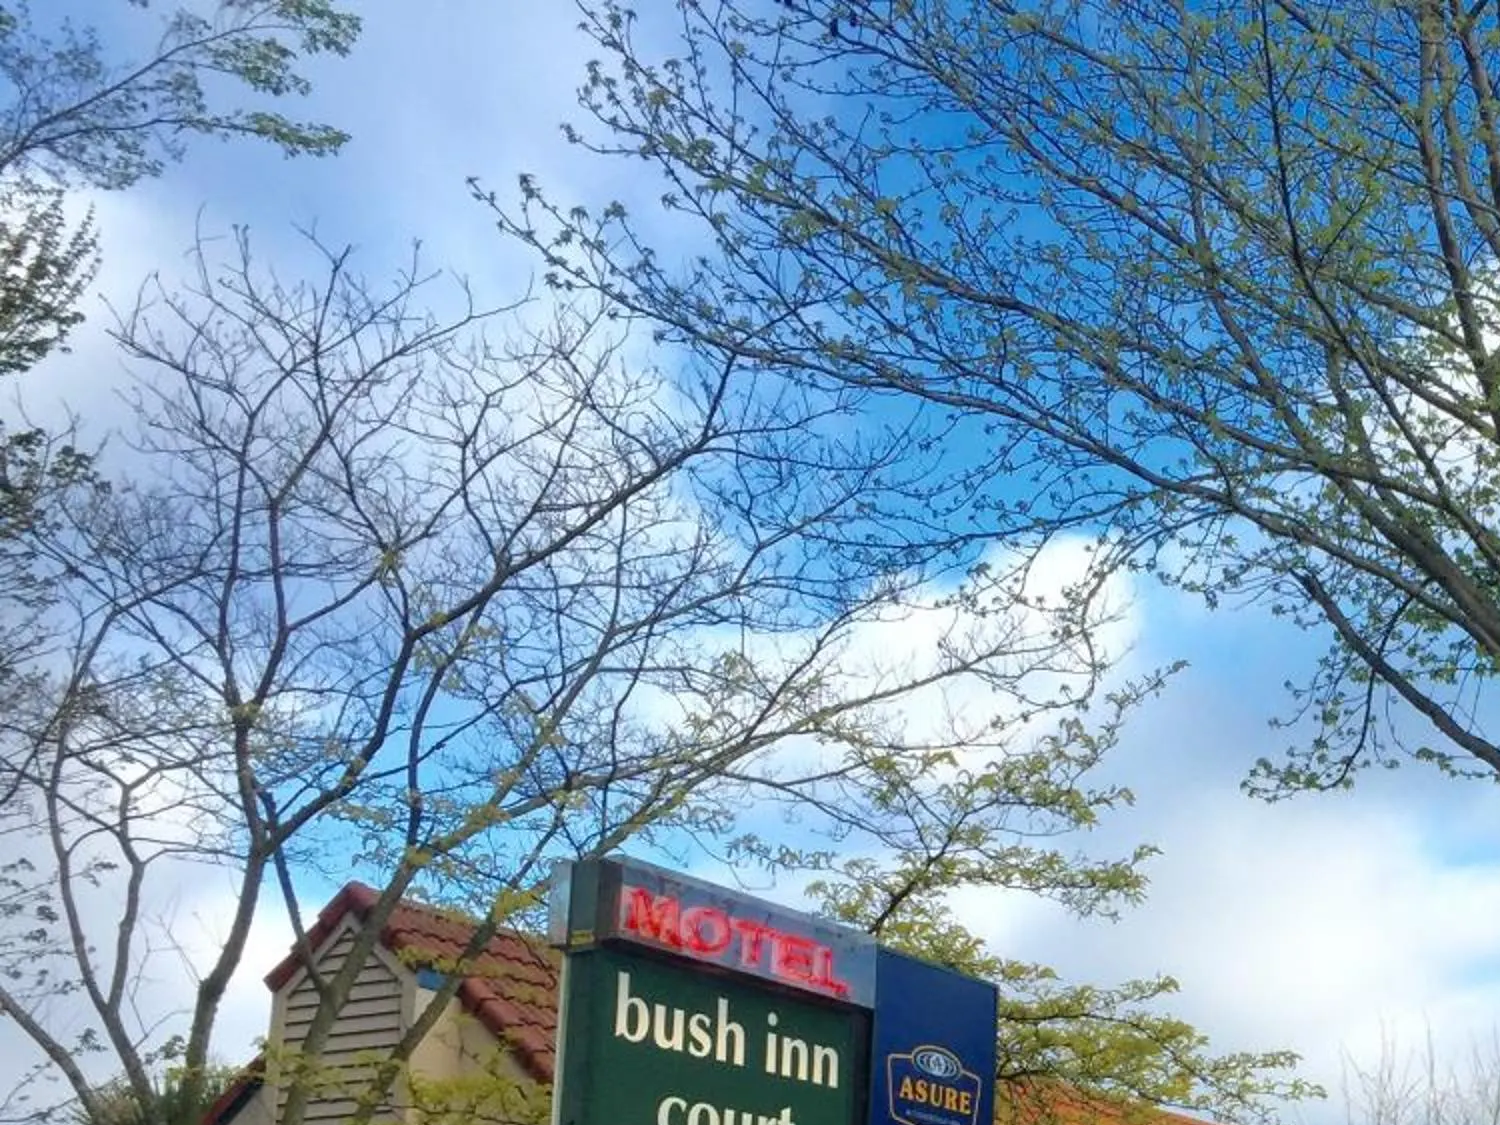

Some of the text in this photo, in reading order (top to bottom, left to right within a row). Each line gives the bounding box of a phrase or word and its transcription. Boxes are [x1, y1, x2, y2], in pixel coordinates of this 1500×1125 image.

[619, 885, 851, 999] MOTEL
[615, 971, 840, 1089] bush inn
[899, 1075, 972, 1115] ASURE
